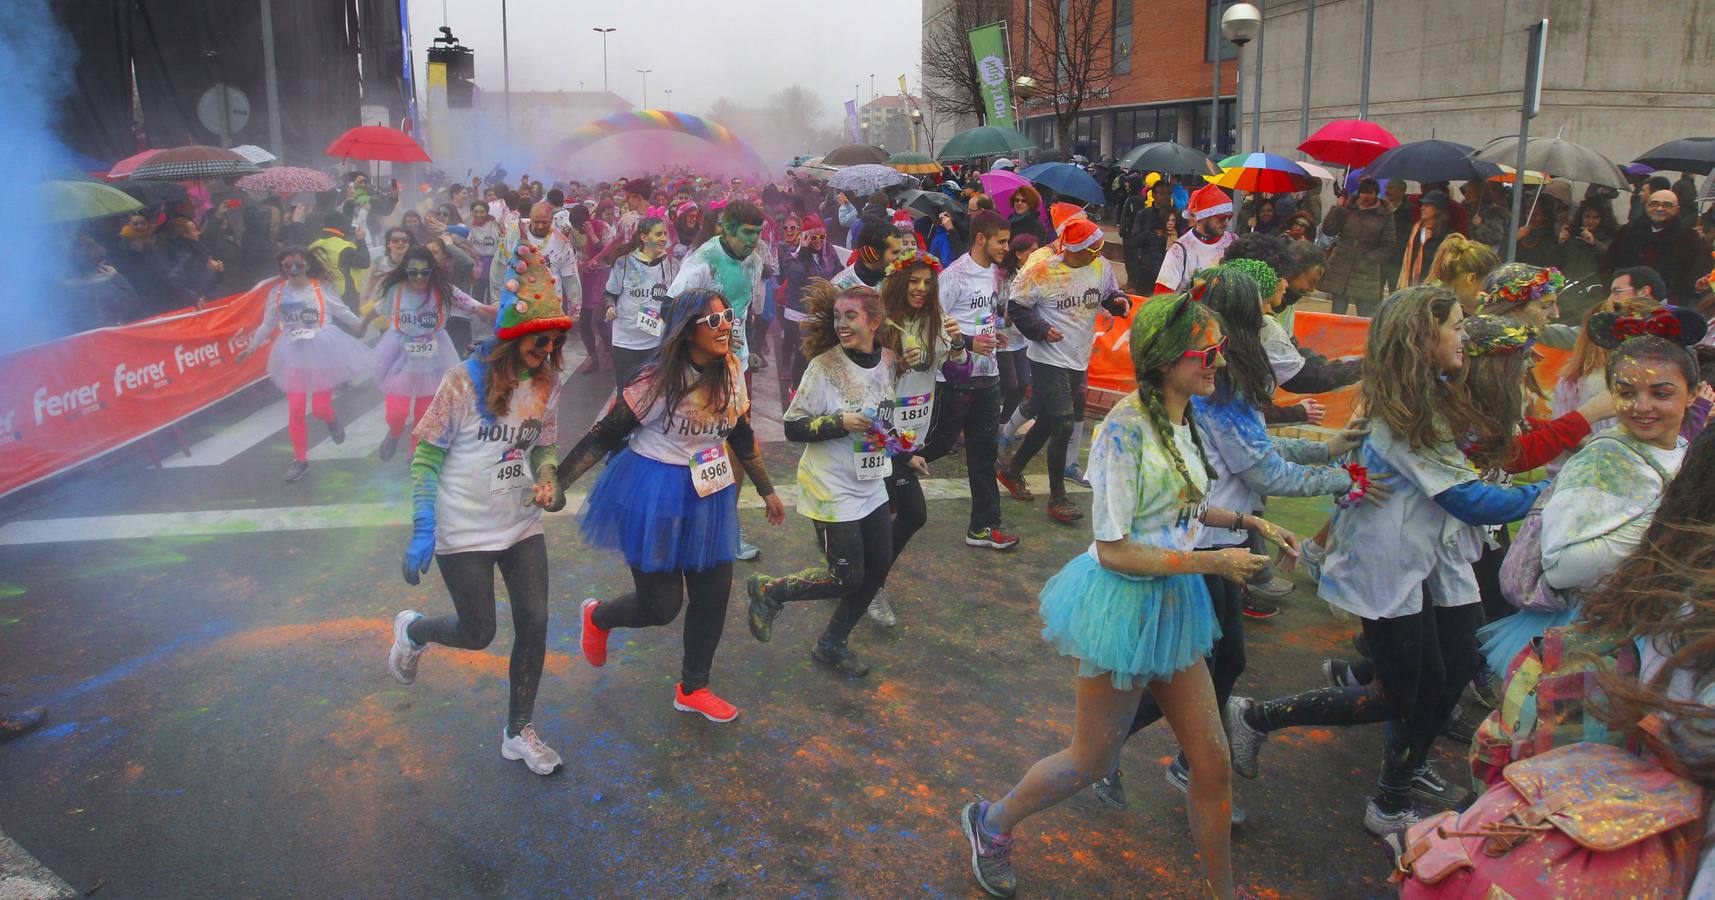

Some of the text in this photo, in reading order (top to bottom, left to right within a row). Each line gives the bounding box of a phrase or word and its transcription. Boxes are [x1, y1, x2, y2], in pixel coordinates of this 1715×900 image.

[1056, 294, 1099, 310] HOLI RUN
[408, 344, 434, 353] 2392
[174, 340, 220, 375] Ferrer
[114, 358, 165, 397] Ferrer
[34, 381, 101, 426] Ferrer
[878, 407, 892, 420] RU
[901, 406, 929, 421] 1810
[477, 424, 515, 444] HOLI
[678, 419, 714, 436] HOLI
[860, 456, 885, 469] 1811
[497, 463, 525, 481] 498
[701, 461, 728, 482] 4968
